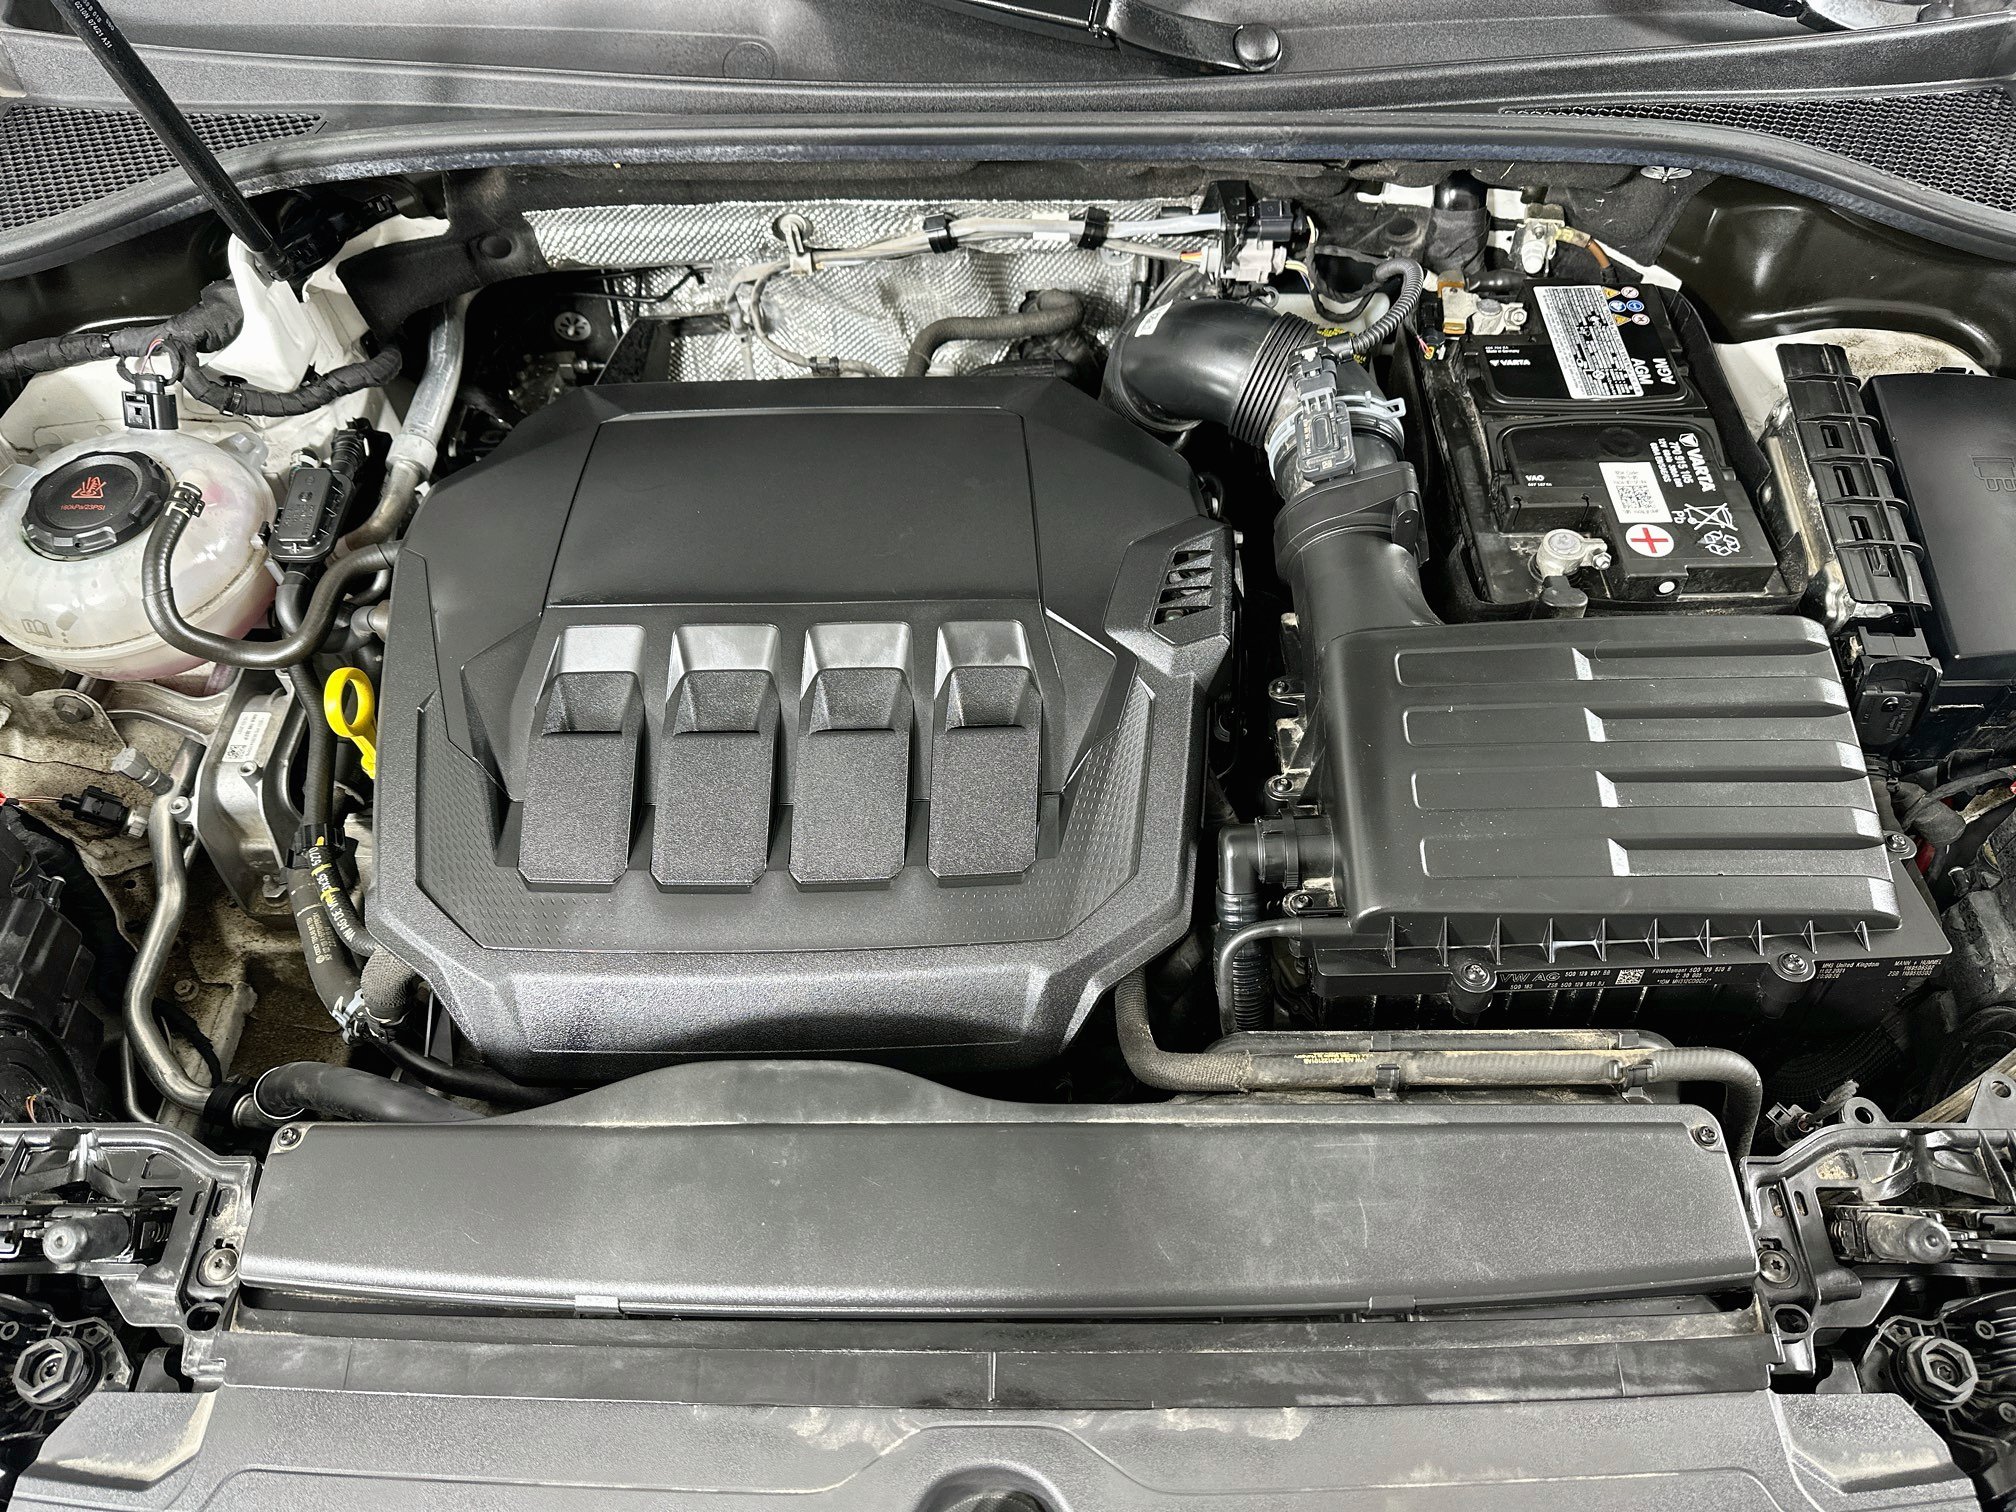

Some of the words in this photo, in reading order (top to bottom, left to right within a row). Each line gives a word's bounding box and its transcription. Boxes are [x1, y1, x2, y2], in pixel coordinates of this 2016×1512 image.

[1631, 357, 1654, 385] AGM
[1652, 357, 1677, 385] AGM
[1674, 456, 1688, 469] 915
[1680, 470, 1694, 484] 105
[1686, 447, 1716, 493] VARTA
[1671, 510, 1687, 524] Pb
[308, 847, 322, 867] 5270
[331, 907, 345, 922] DE
[336, 918, 350, 931] AG
[1499, 973, 1531, 982] VW
[1531, 972, 1561, 982] AG
